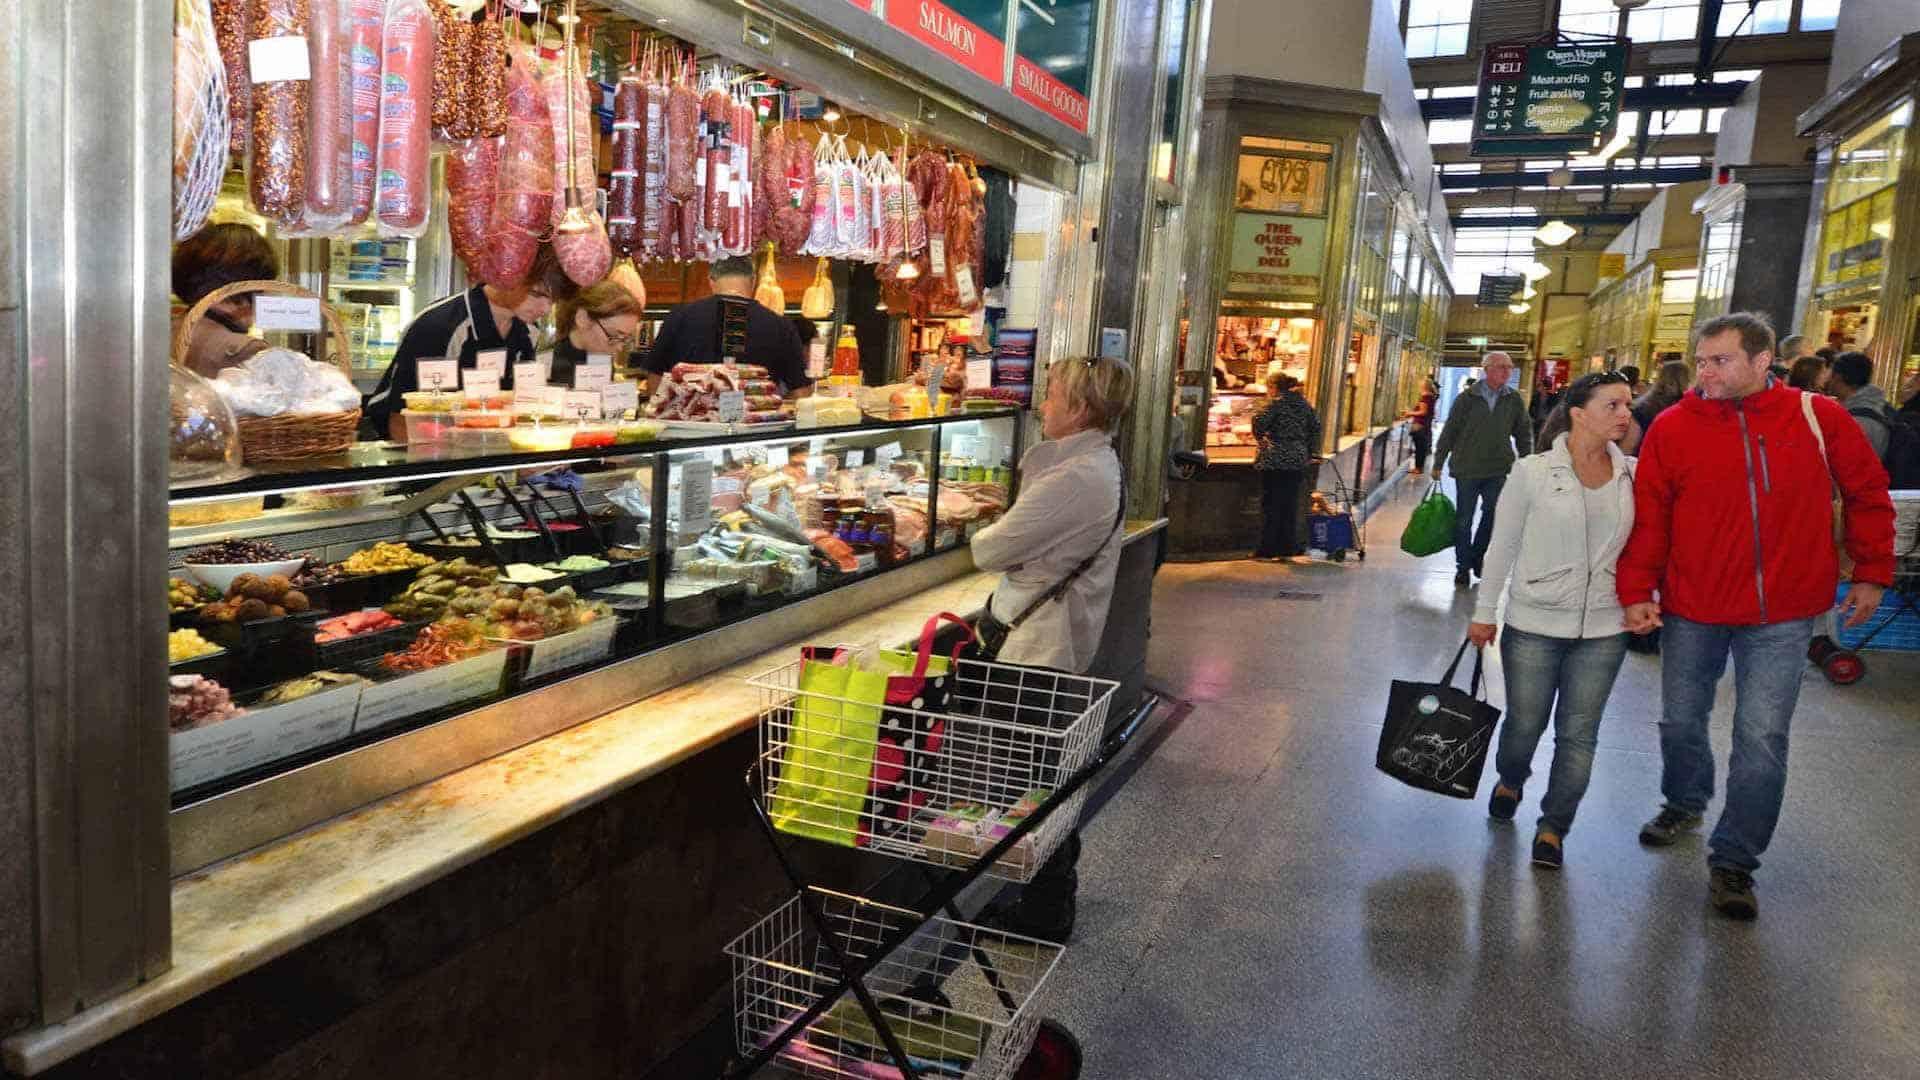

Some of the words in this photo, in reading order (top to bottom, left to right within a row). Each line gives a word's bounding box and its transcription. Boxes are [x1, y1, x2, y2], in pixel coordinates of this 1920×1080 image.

[920, 1, 977, 56] SALMON
[1492, 62, 1522, 73] DELI
[1531, 74, 1553, 85] Meat
[1552, 74, 1573, 84] and
[1573, 73, 1590, 84] Fish
[1019, 64, 1051, 104] SMALL
[1053, 86, 1083, 122] GOODS
[1529, 89, 1550, 100] Fruit
[1551, 89, 1569, 99] and
[1568, 89, 1586, 101] Veg
[1266, 223, 1293, 234] THE
[1254, 234, 1303, 246] QUEEN
[1265, 246, 1289, 256] VIC
[1258, 257, 1290, 268] DELI
